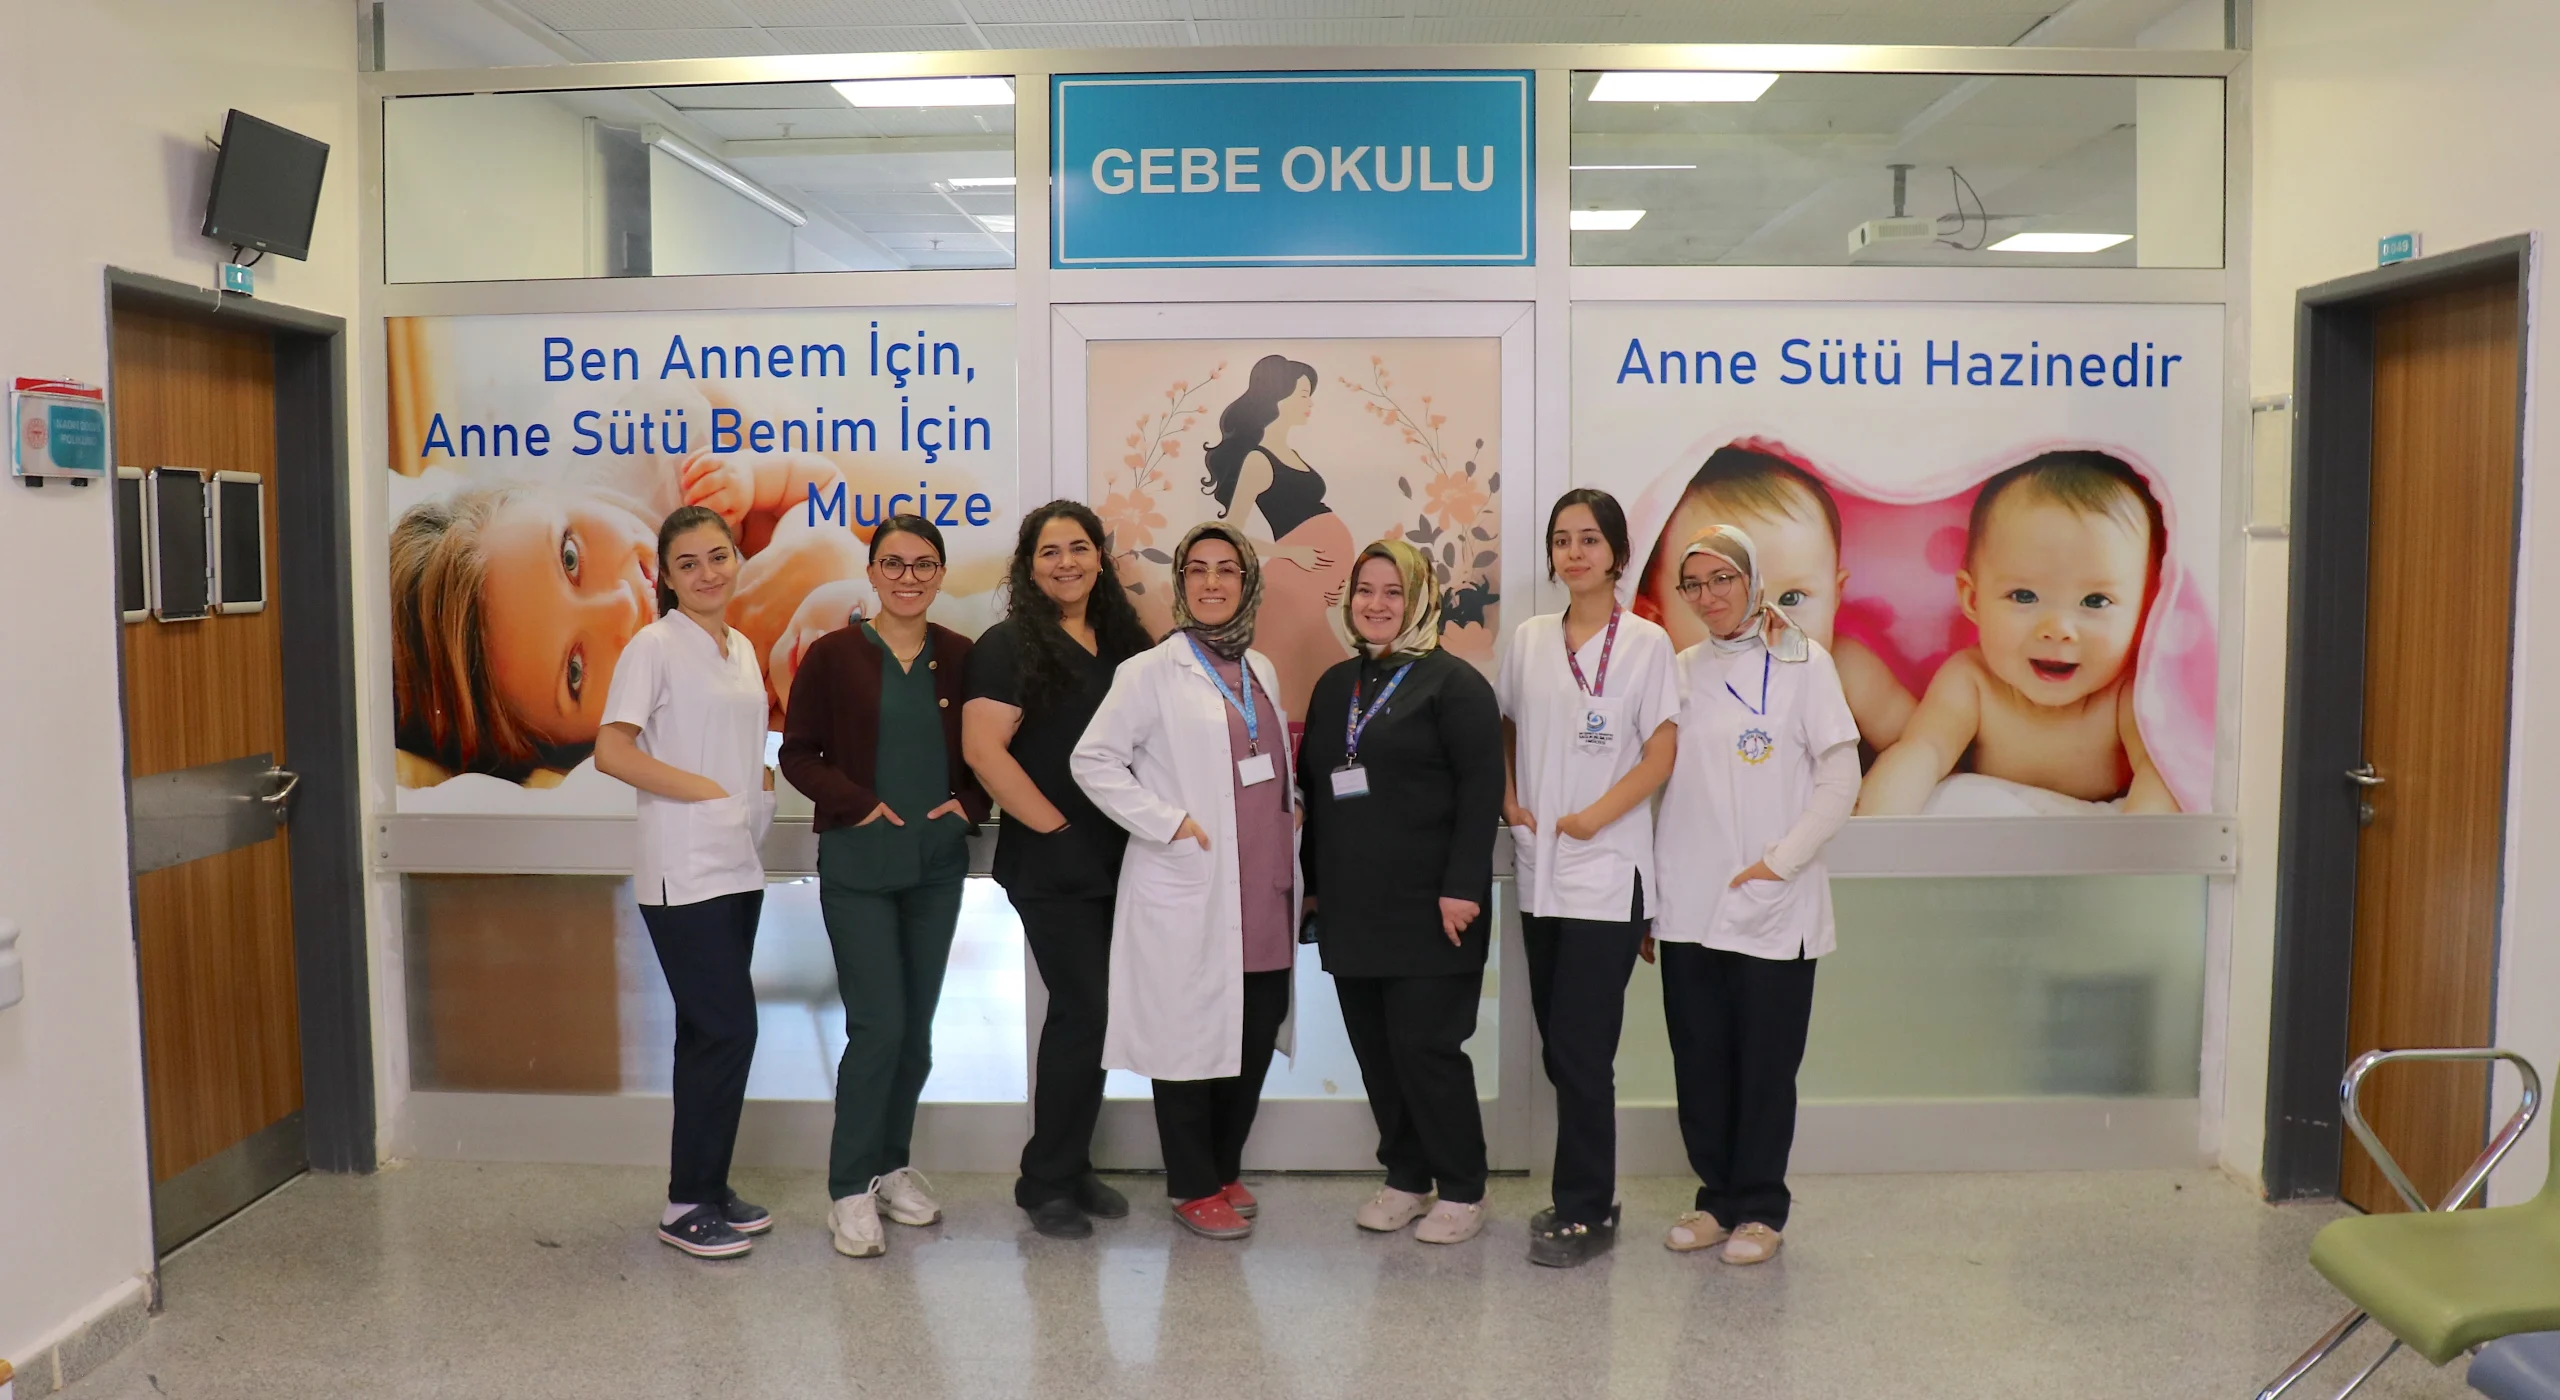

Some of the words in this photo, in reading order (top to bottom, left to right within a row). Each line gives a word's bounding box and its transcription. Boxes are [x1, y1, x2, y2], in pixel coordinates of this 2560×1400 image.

[1091, 147, 1261, 195] GEBE
[1281, 145, 1495, 193] OKULU
[544, 337, 639, 382] Ben
[660, 335, 846, 381] Annem
[870, 320, 976, 389] İçin,
[1616, 338, 1757, 385] Anne
[1780, 338, 1902, 386] Sütü
[1927, 339, 2184, 388] Hazinedir
[422, 413, 551, 458] Anne
[573, 410, 688, 457] Sütü
[711, 407, 877, 454] Benim
[900, 395, 992, 465] İçin
[807, 480, 993, 527] Mucize
